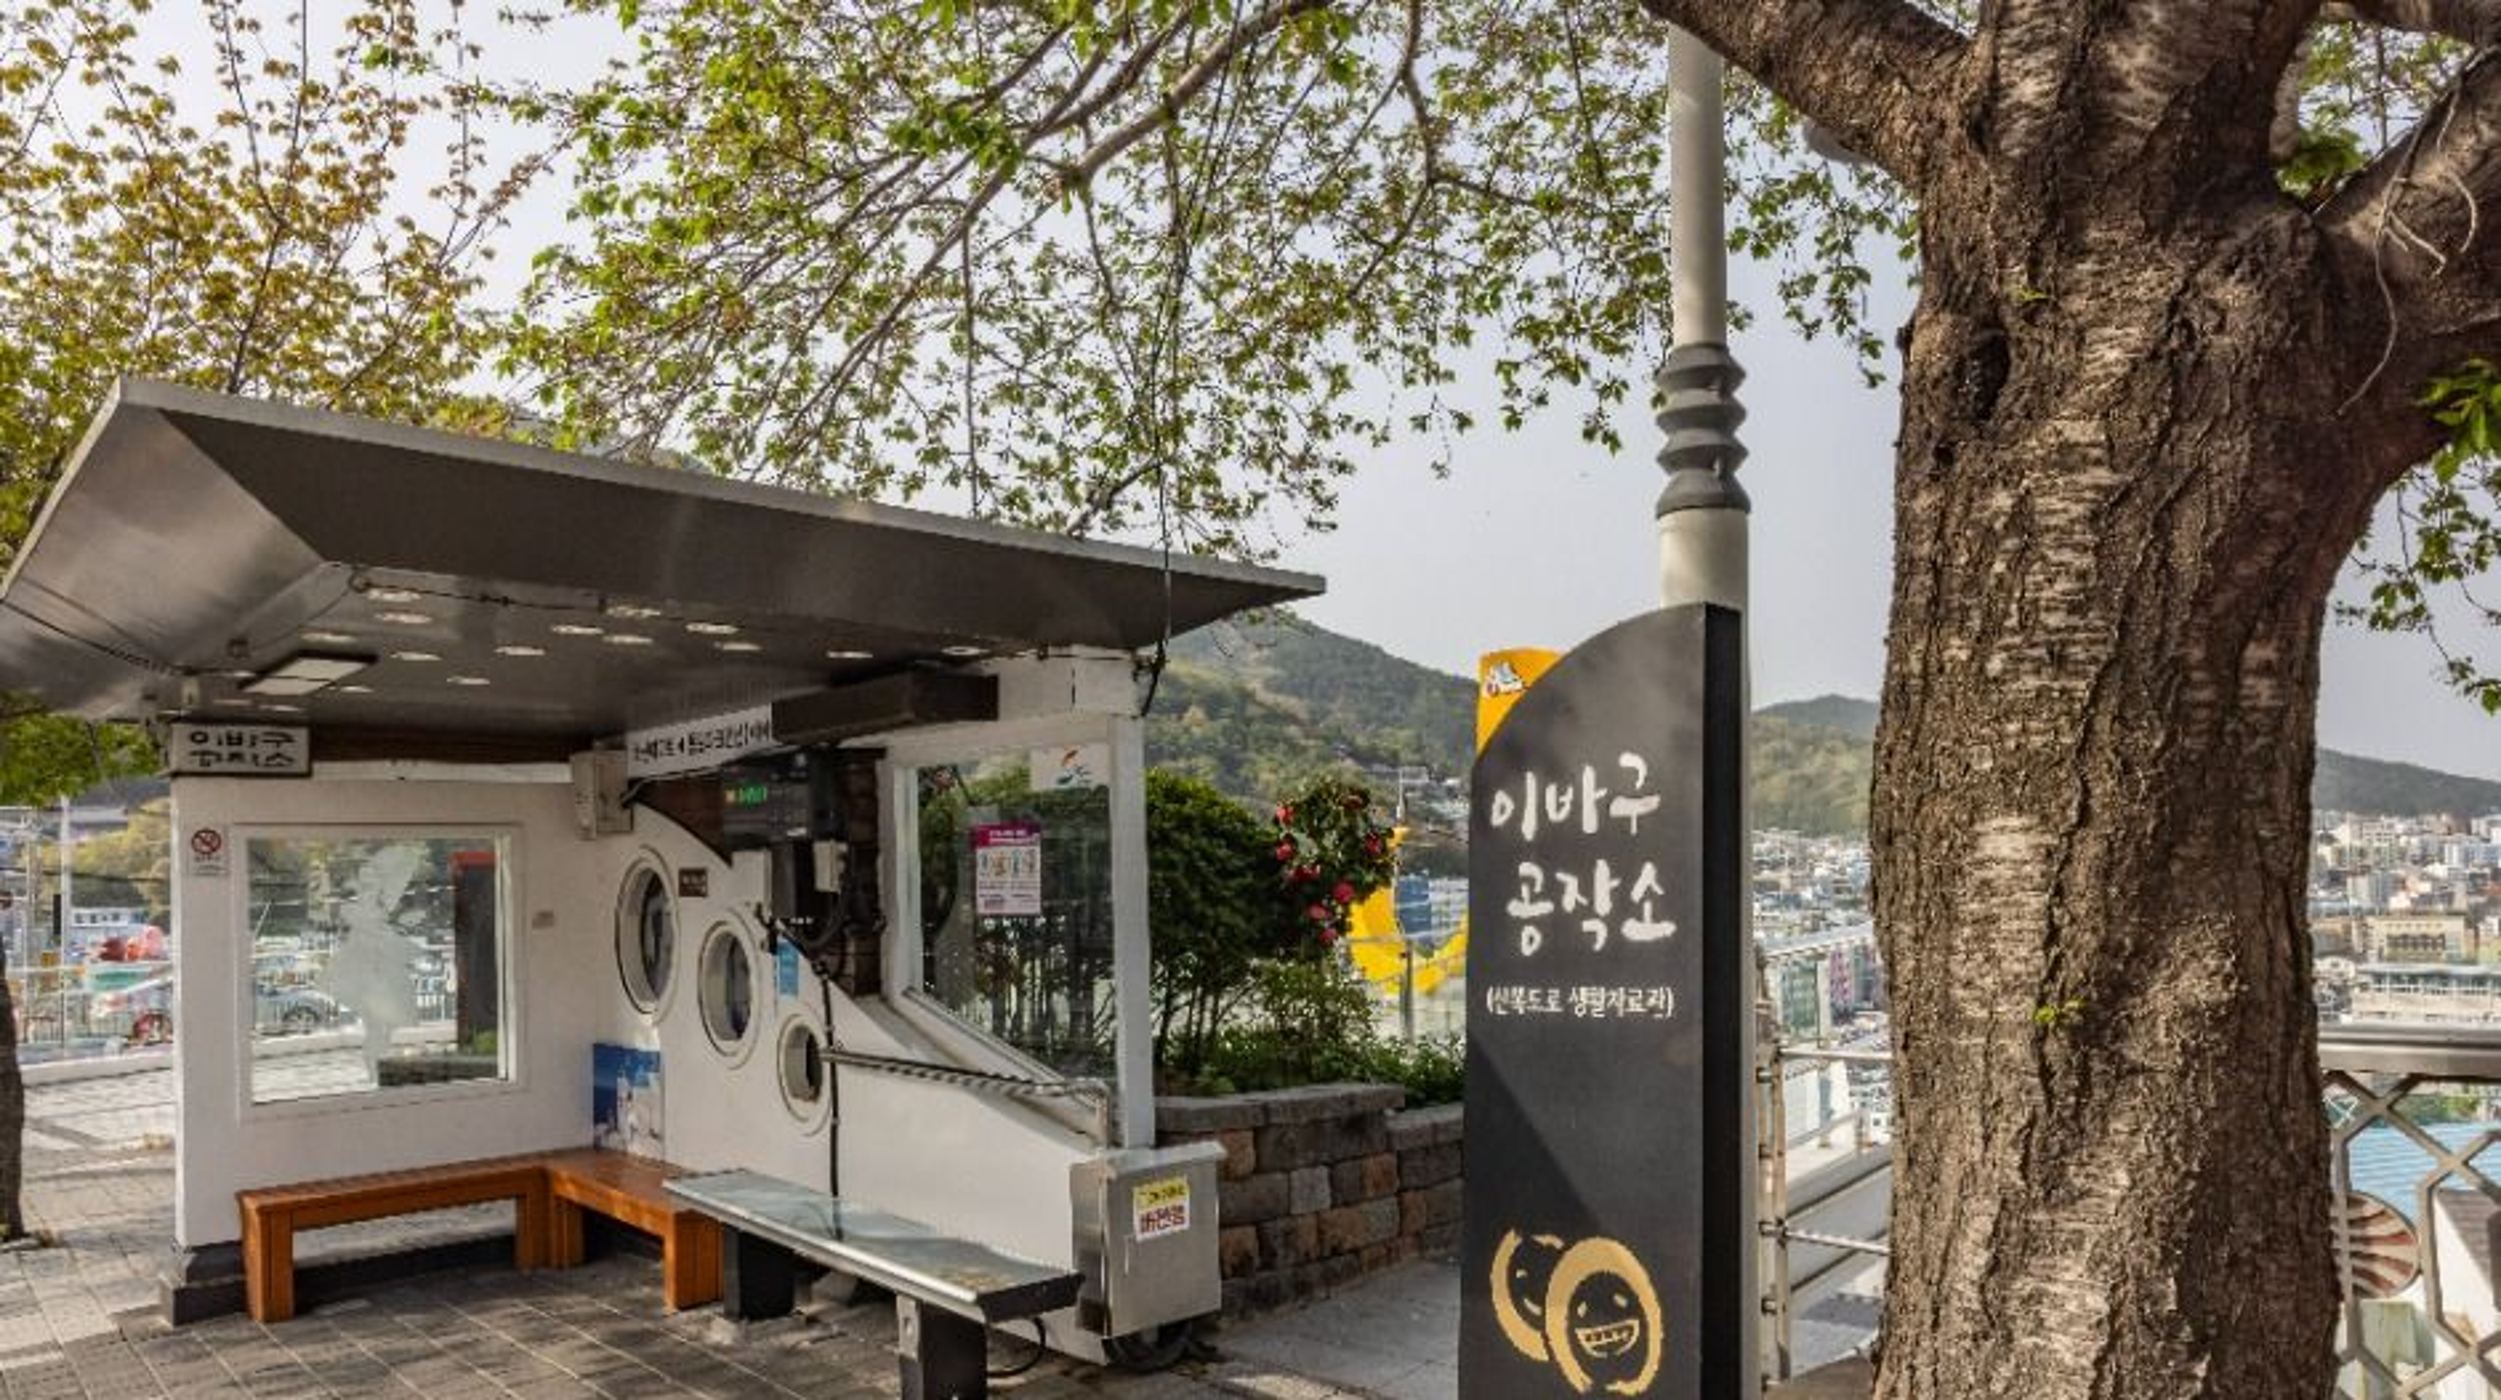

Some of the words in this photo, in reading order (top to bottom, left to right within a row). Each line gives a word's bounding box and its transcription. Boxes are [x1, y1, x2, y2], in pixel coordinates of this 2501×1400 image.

[189, 730, 296, 748] 이바구
[1490, 752, 1661, 841] 이바구
[1507, 859, 1676, 956] 공작소
[1486, 985, 1564, 1016] (산복도로
[1569, 985, 1675, 1018] 생활자료관)
